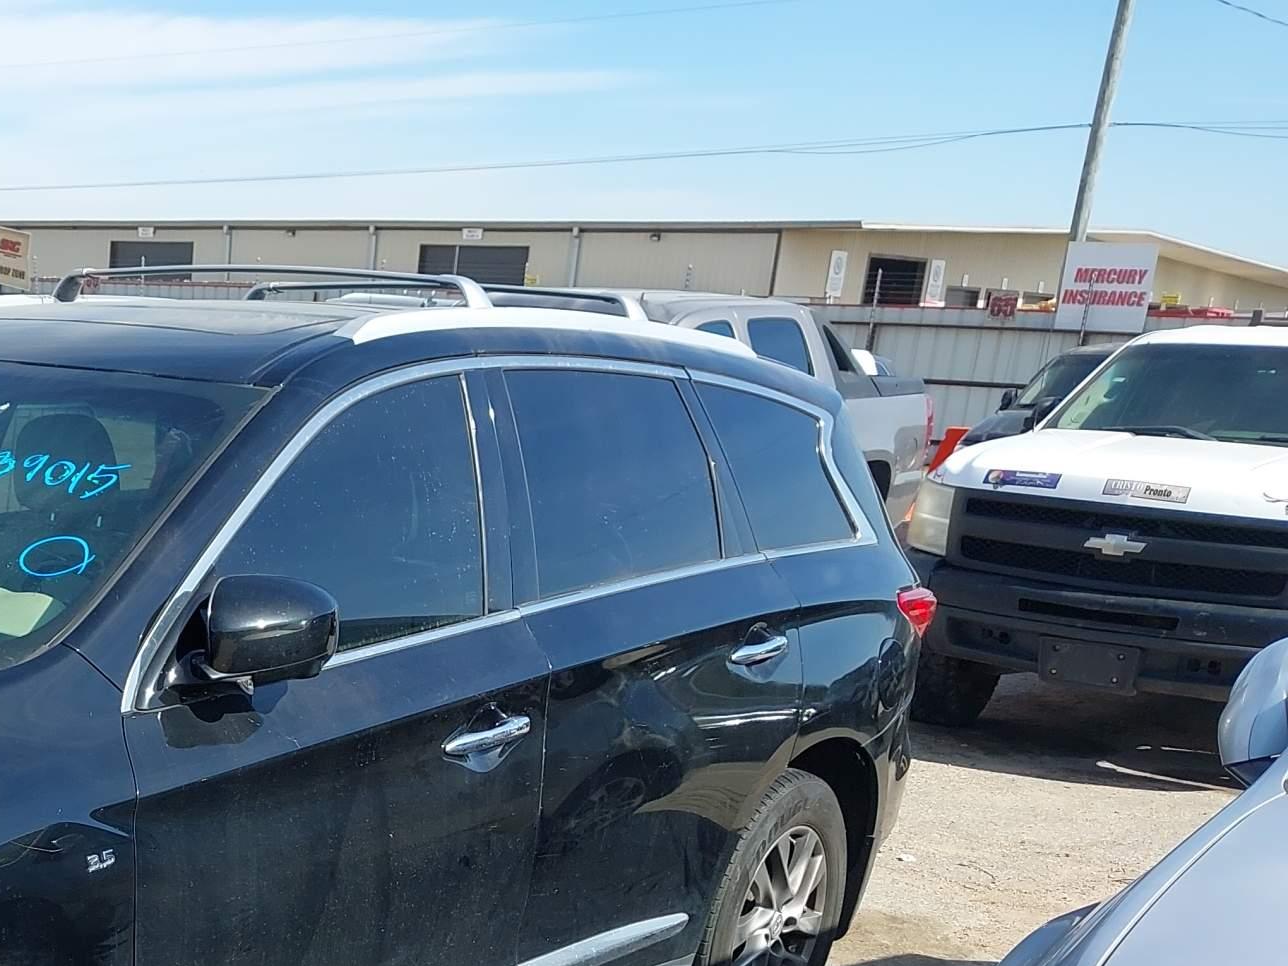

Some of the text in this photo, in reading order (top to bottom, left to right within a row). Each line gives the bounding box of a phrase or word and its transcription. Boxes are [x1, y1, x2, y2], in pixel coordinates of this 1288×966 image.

[1074, 267, 1148, 285] MERCURY
[1062, 288, 1147, 307] INSURANCE
[1144, 484, 1173, 498] Pronto
